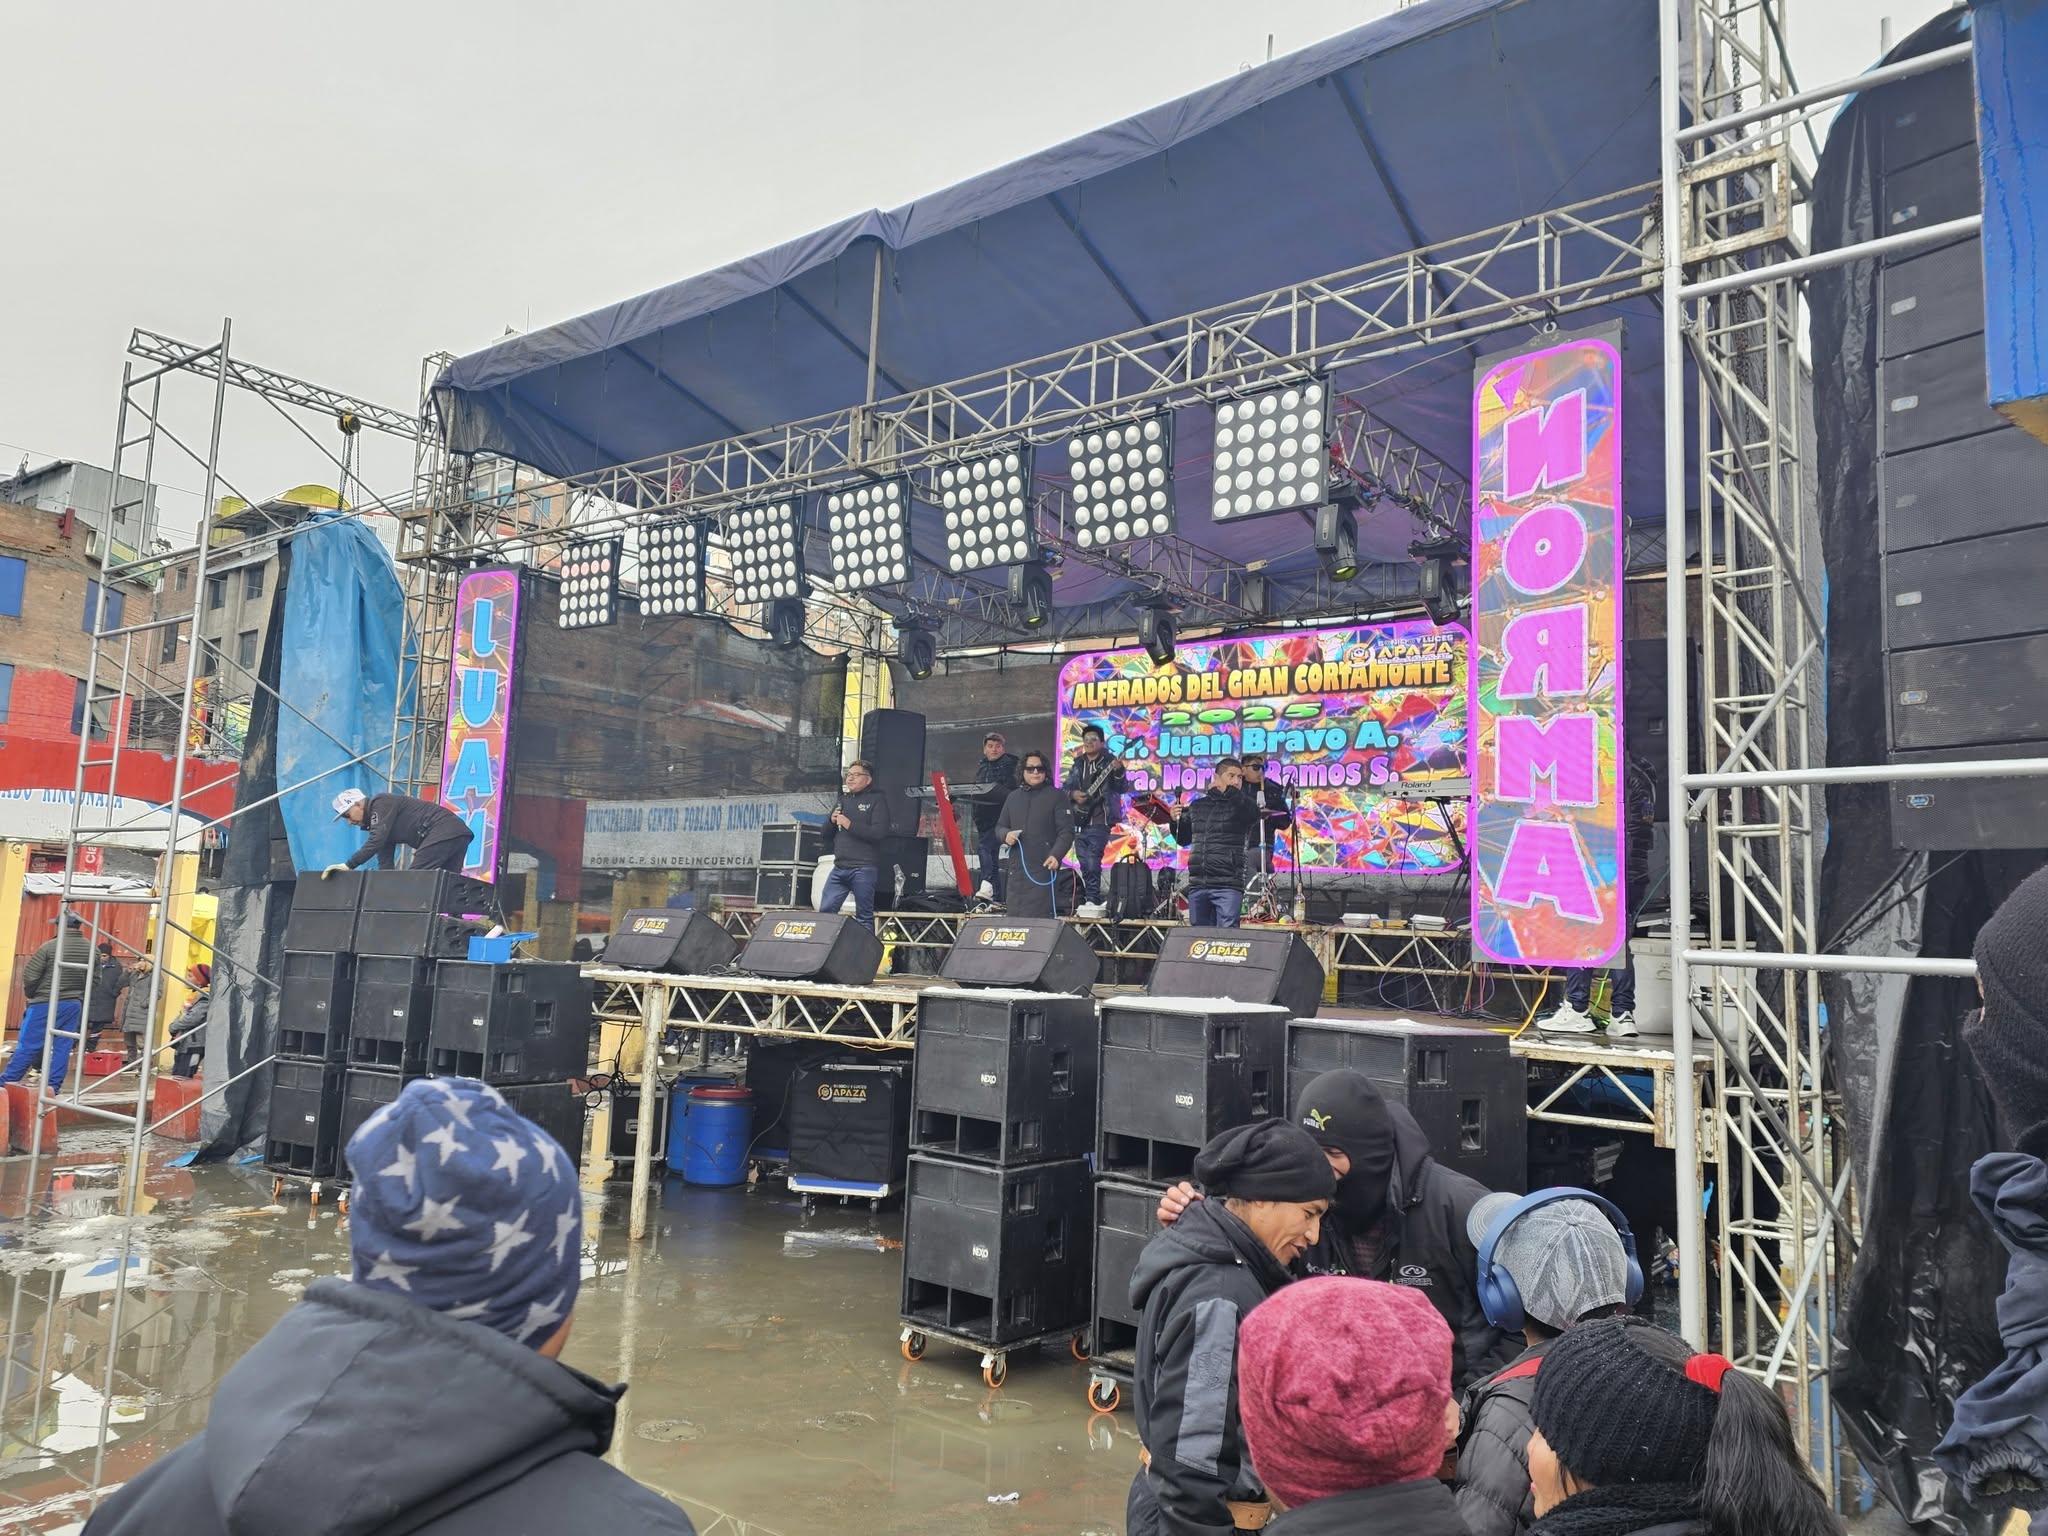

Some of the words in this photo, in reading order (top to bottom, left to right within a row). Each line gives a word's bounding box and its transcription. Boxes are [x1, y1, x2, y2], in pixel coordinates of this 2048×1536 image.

[1378, 641, 1453, 658] APAZA
[1072, 674, 1183, 709] ALFERADOS
[1186, 671, 1224, 701] DEL
[1228, 665, 1289, 699] GRAN
[1294, 658, 1451, 695] CORTAMONTE
[1161, 703, 1322, 726] 2025
[1155, 732, 1233, 758] Juan
[1242, 727, 1348, 755] Bravo
[1354, 720, 1400, 750] A.
[1125, 769, 1158, 791] ra.
[1162, 763, 1216, 790] Nor
[1369, 755, 1400, 786] S.
[1400, 781, 1432, 789] Roland
[648, 807, 679, 832] CENTRO
[683, 804, 722, 832] POBLADO
[727, 802, 779, 832] RINCONADA
[590, 856, 609, 865] POR
[612, 856, 626, 865] UN
[650, 856, 668, 865] SIN
[671, 856, 754, 866] DELINCUENCIA
[1208, 946, 1248, 957] APAZA
[833, 1088, 867, 1098] APAZA
